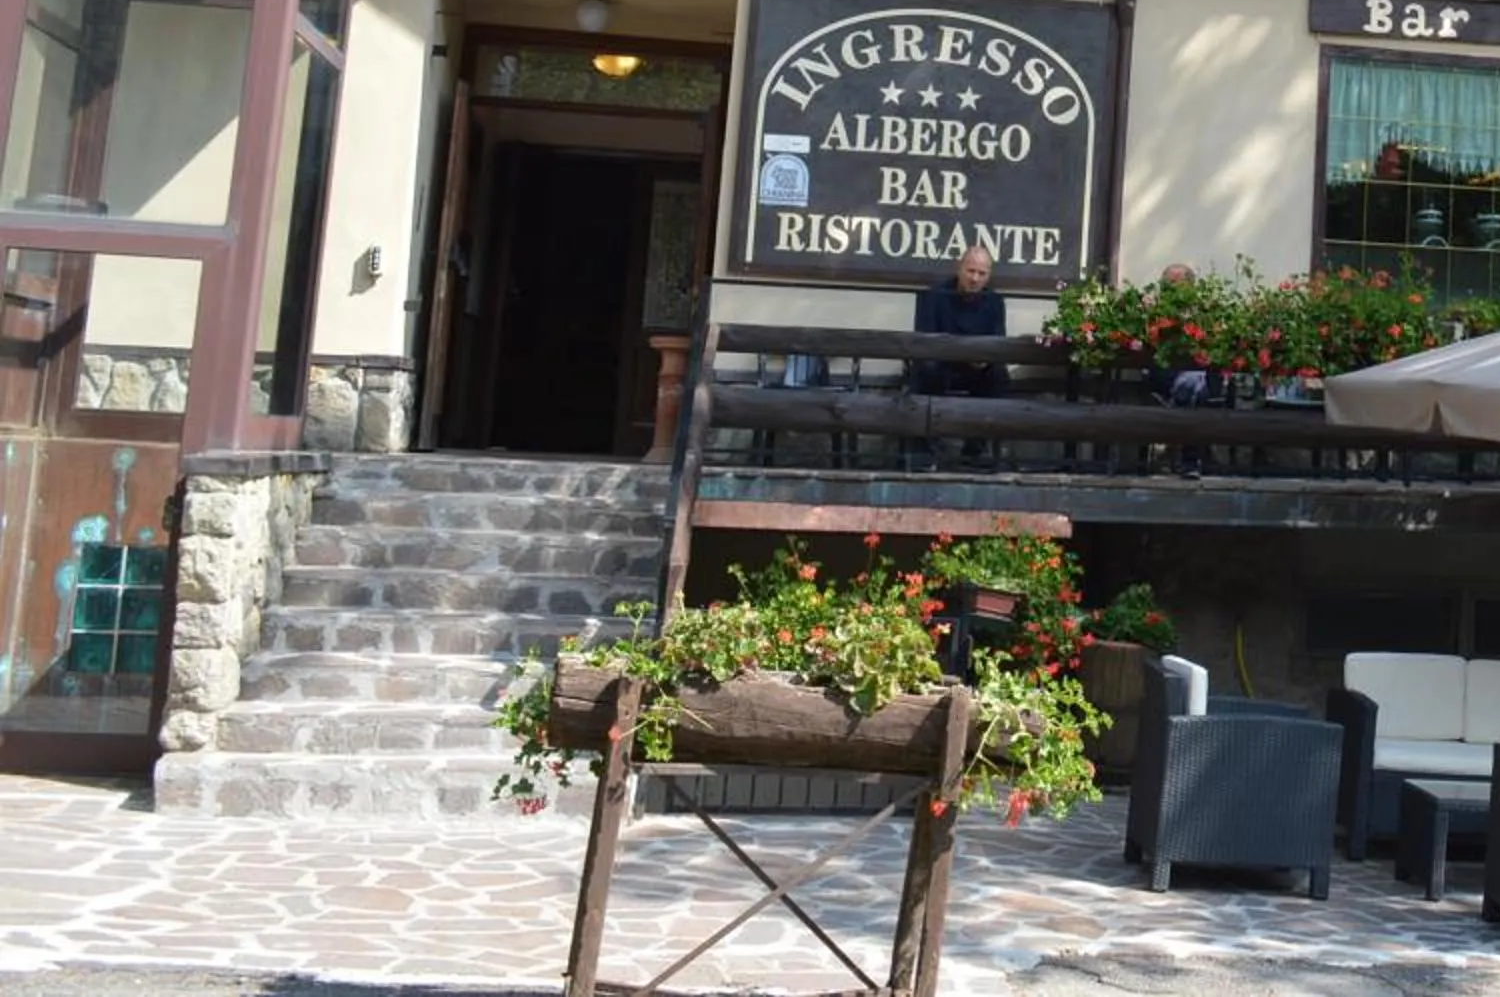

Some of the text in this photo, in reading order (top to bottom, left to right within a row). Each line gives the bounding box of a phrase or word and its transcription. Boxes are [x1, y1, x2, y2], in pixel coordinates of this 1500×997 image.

[771, 24, 1082, 126] INGRESSO
[820, 112, 1032, 163] ALBERGO
[878, 167, 969, 210] BAR
[774, 212, 1062, 266] RISTORANTE
